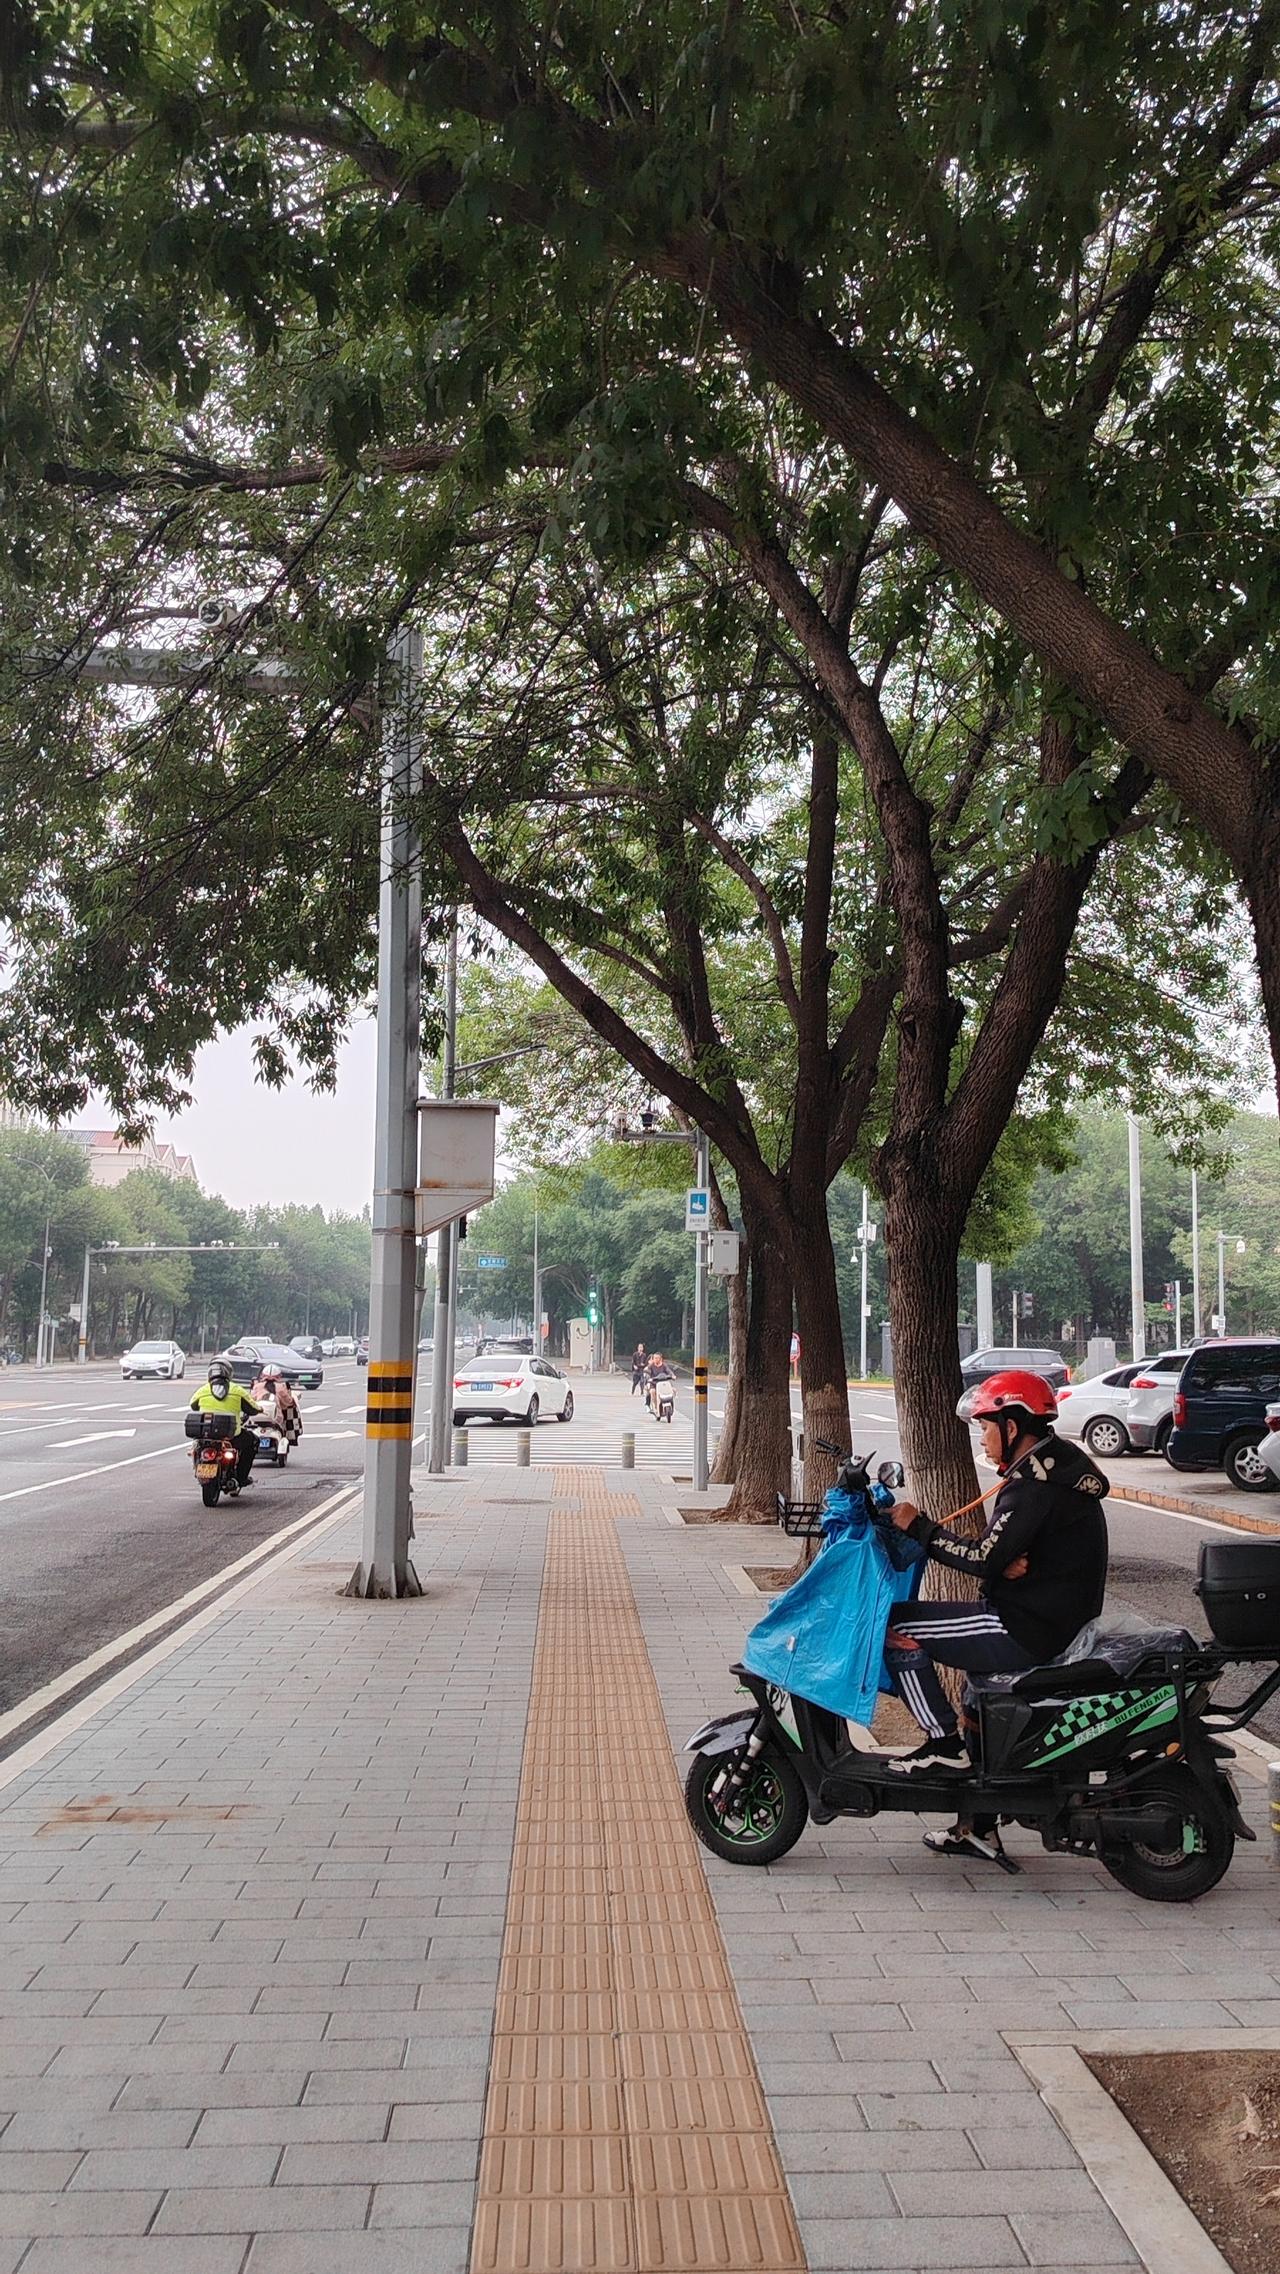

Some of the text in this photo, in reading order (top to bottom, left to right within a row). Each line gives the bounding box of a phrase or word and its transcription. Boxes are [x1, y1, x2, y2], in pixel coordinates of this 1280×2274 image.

[944, 1540, 969, 1558] APE
[1127, 1699, 1154, 1717] FENG
[1152, 1689, 1170, 1703] XIA
